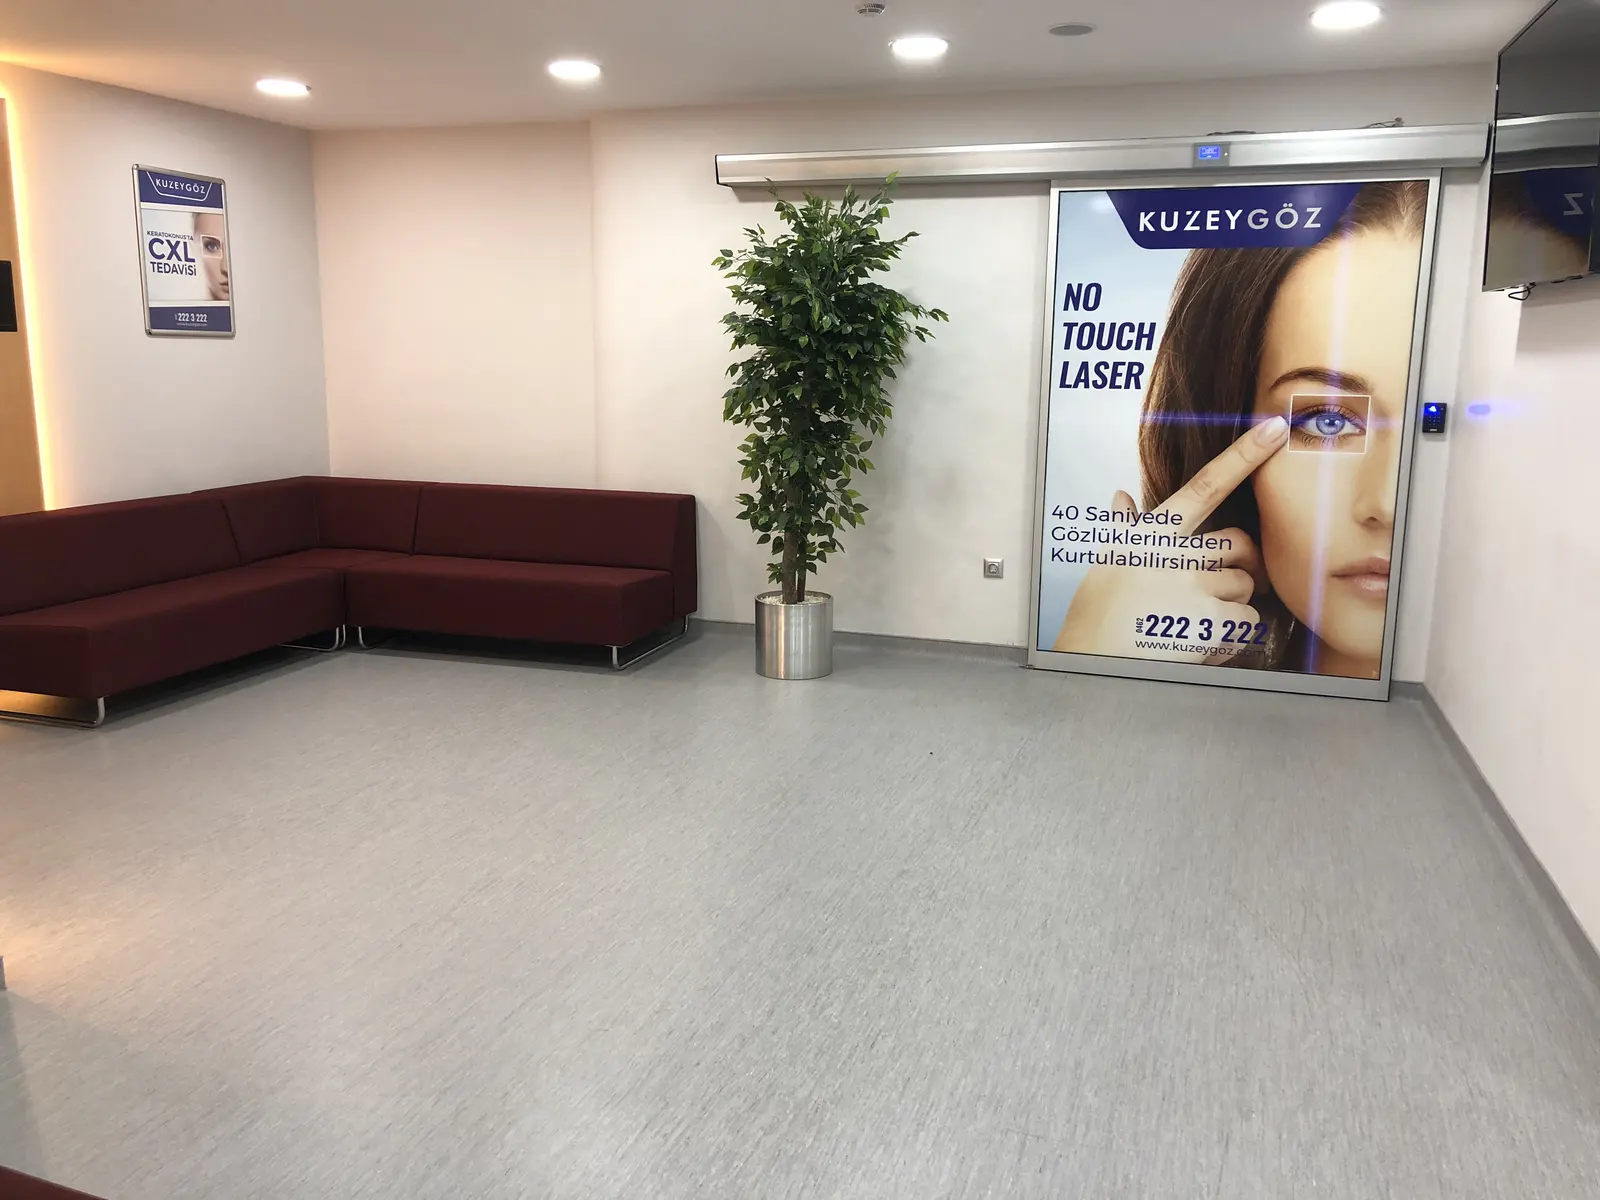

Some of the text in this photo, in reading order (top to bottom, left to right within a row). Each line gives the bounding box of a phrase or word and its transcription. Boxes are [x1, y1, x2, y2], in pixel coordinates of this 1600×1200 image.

[155, 178, 206, 194] KUZEYGÖZ
[1138, 202, 1322, 232] KUZEYGÖZ
[148, 237, 196, 263] CXL
[1062, 282, 1102, 312] NO
[177, 312, 190, 322] 222
[190, 313, 195, 322] 3
[195, 313, 208, 323] 222
[1062, 321, 1157, 351] TOUCH
[1058, 360, 1145, 390] LASER
[1051, 504, 1183, 527] 40 Saniyede
[1051, 526, 1233, 551] Gözlüklerinizden
[1051, 547, 1224, 572] Kurtulabilirsiniz!
[1135, 614, 1268, 645] 0462 222 3 222
[1135, 640, 1265, 657] www.kuzeygoz.com
